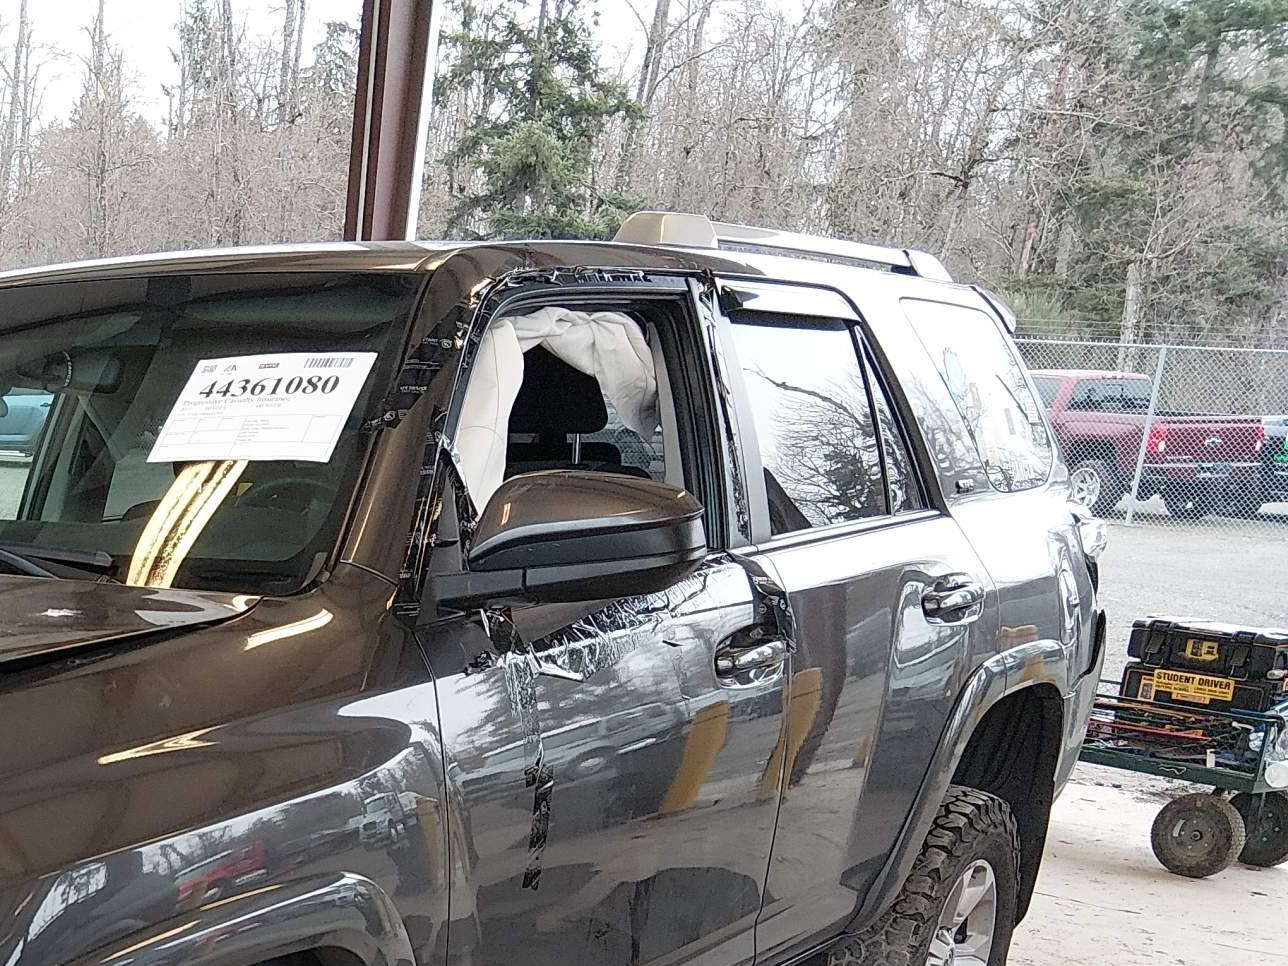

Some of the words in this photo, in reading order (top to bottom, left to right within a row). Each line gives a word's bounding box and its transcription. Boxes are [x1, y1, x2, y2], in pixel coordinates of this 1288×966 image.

[199, 375, 340, 398] 44361080
[1156, 672, 1196, 685] STUDENT
[1198, 678, 1231, 690] DRIVER
